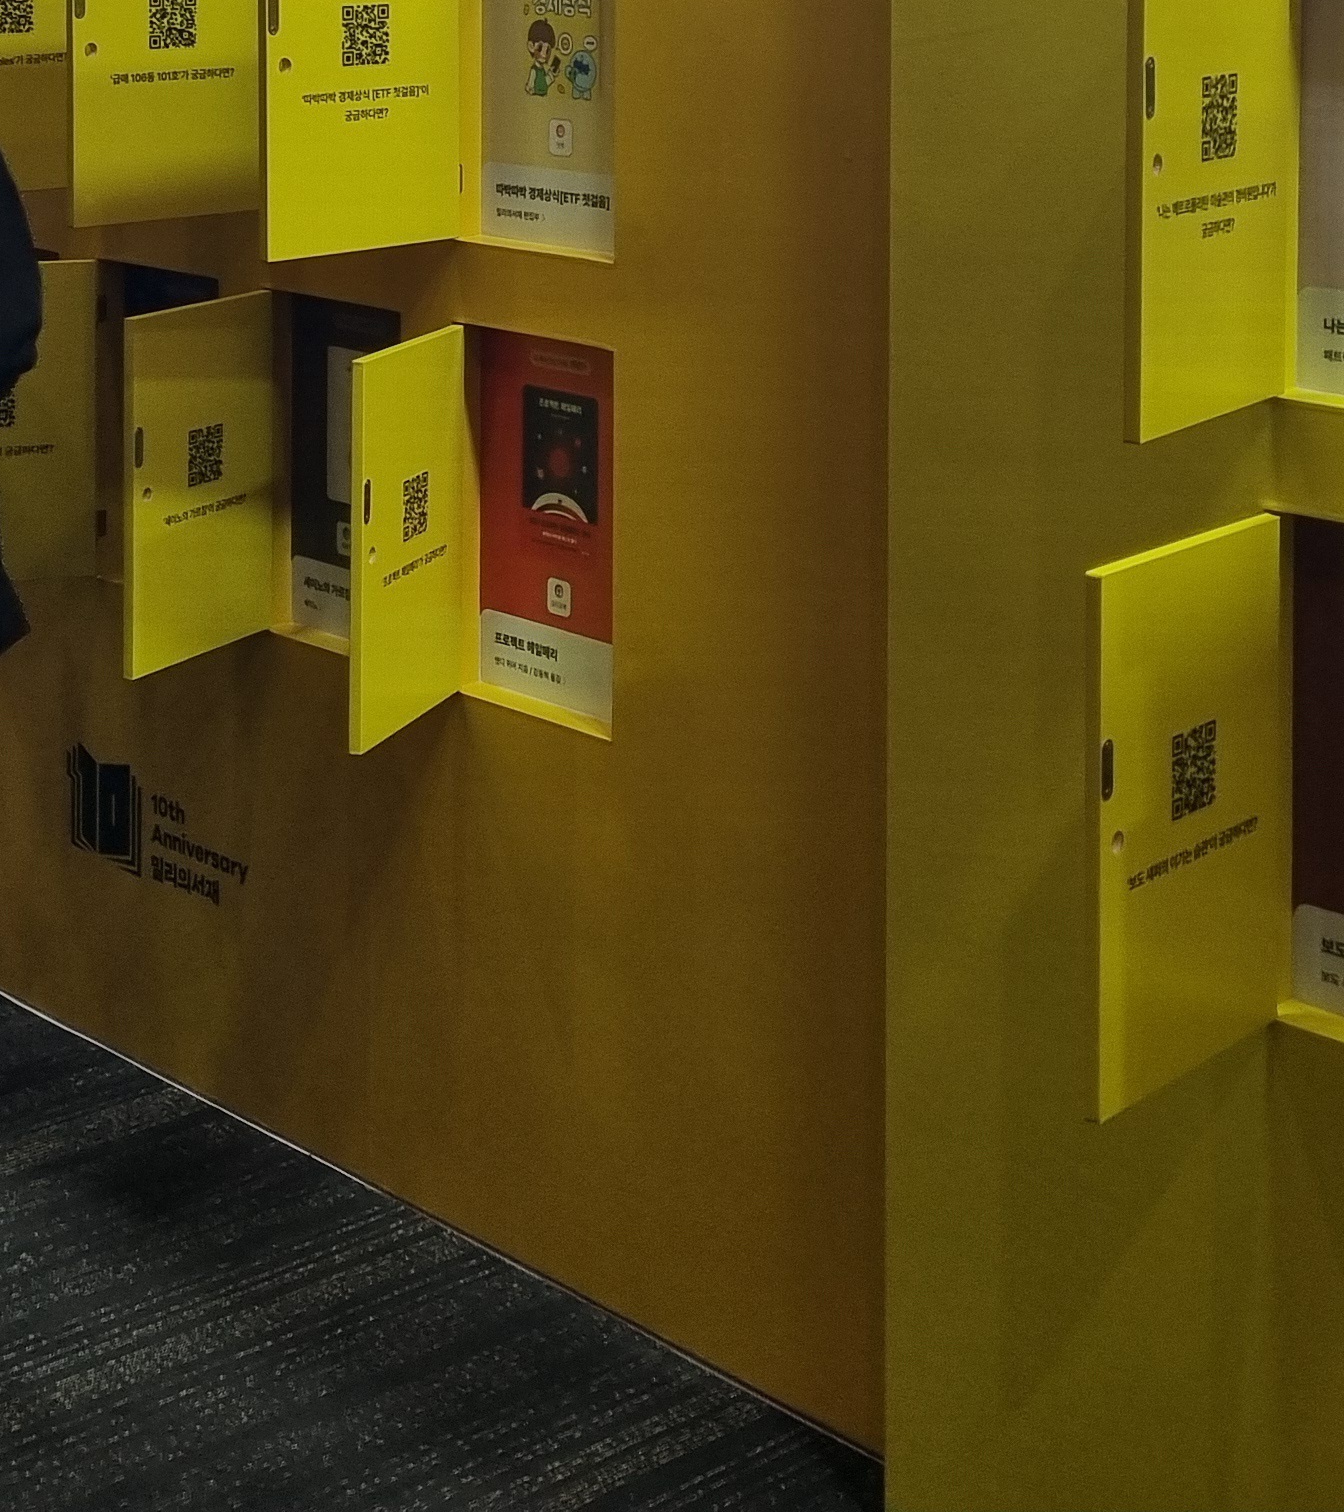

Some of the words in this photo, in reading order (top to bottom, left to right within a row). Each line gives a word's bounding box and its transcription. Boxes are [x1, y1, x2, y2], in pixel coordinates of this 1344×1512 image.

[345, 108, 389, 122] 궁금하다면?
[494, 631, 526, 651] 프로젝트
[151, 794, 185, 824] 10th
[150, 823, 249, 885] Anniversary
[150, 854, 220, 907] 밀리의서재
